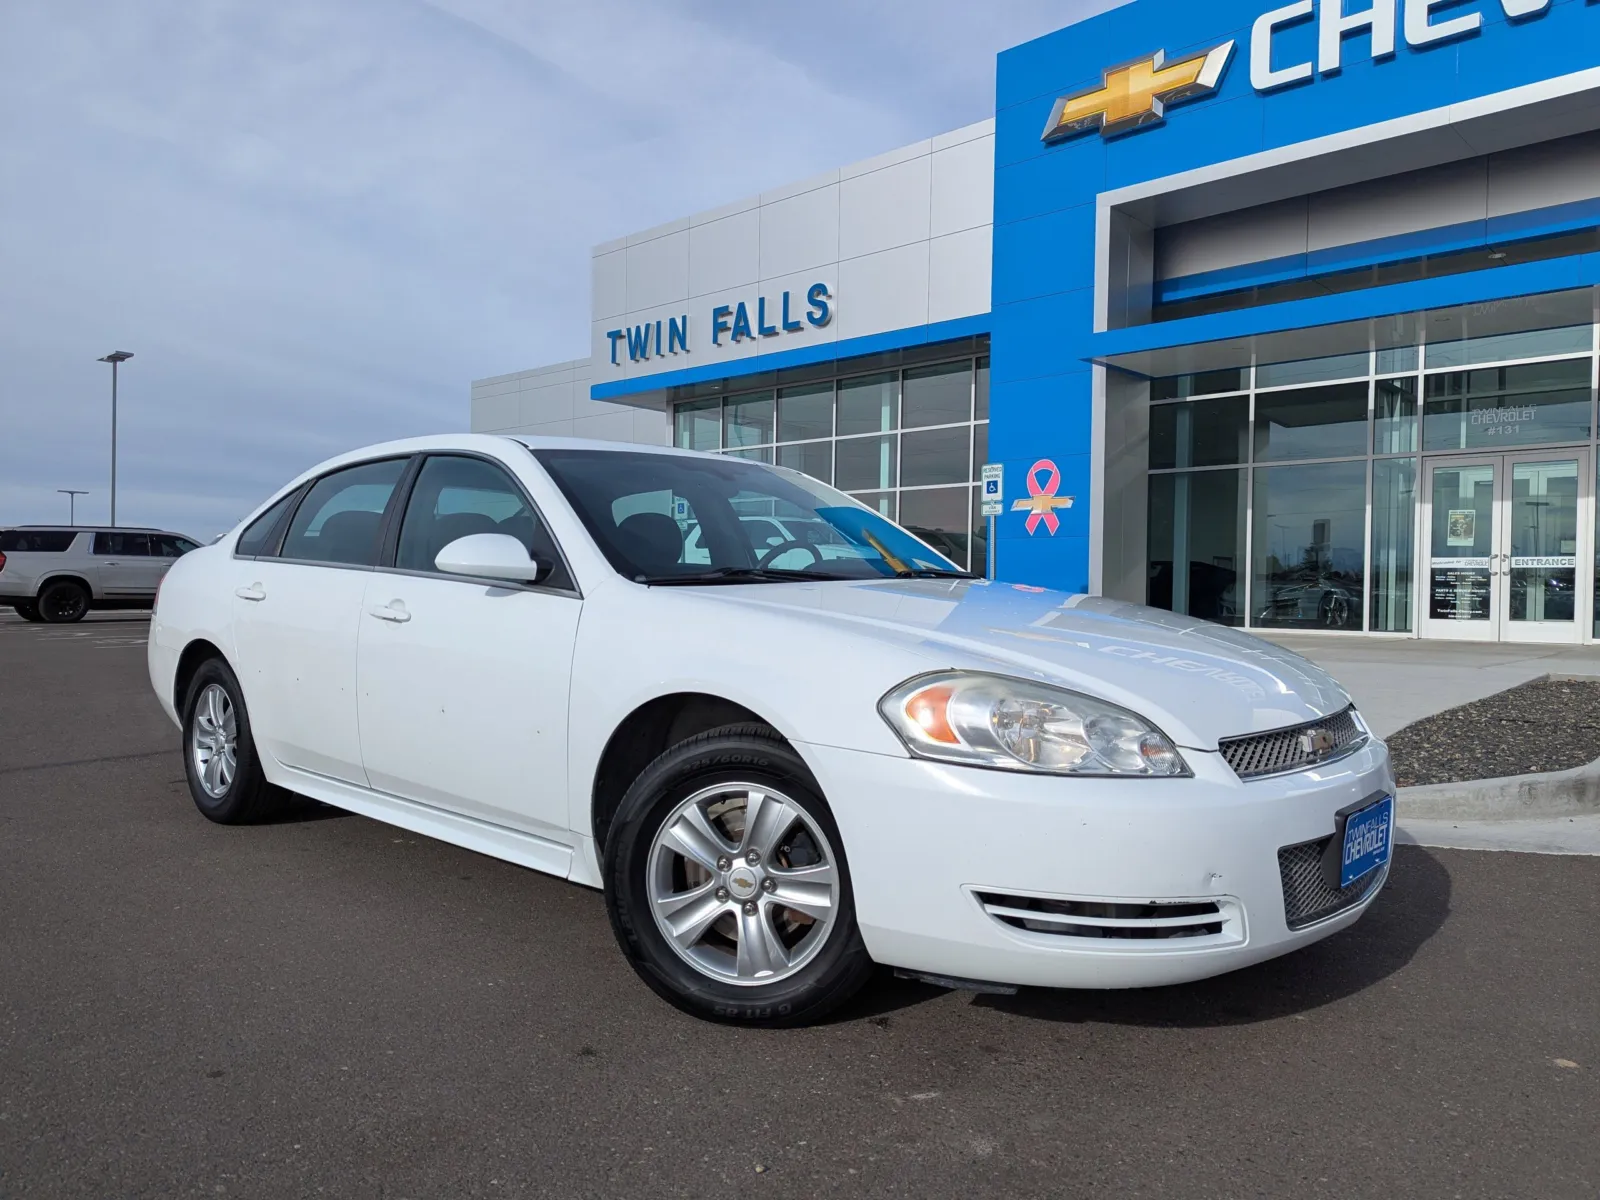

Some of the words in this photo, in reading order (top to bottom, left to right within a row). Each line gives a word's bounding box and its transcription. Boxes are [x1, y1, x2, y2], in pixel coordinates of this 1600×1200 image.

[1250, 0, 1548, 92] CHE
[606, 314, 690, 364] TWIN
[712, 282, 833, 347] FALLS
[1471, 410, 1536, 425] CHEVROLET
[1487, 424, 1520, 436] #131
[1514, 558, 1575, 567] ENTRANCE
[1344, 824, 1388, 865] CHEVROLET
